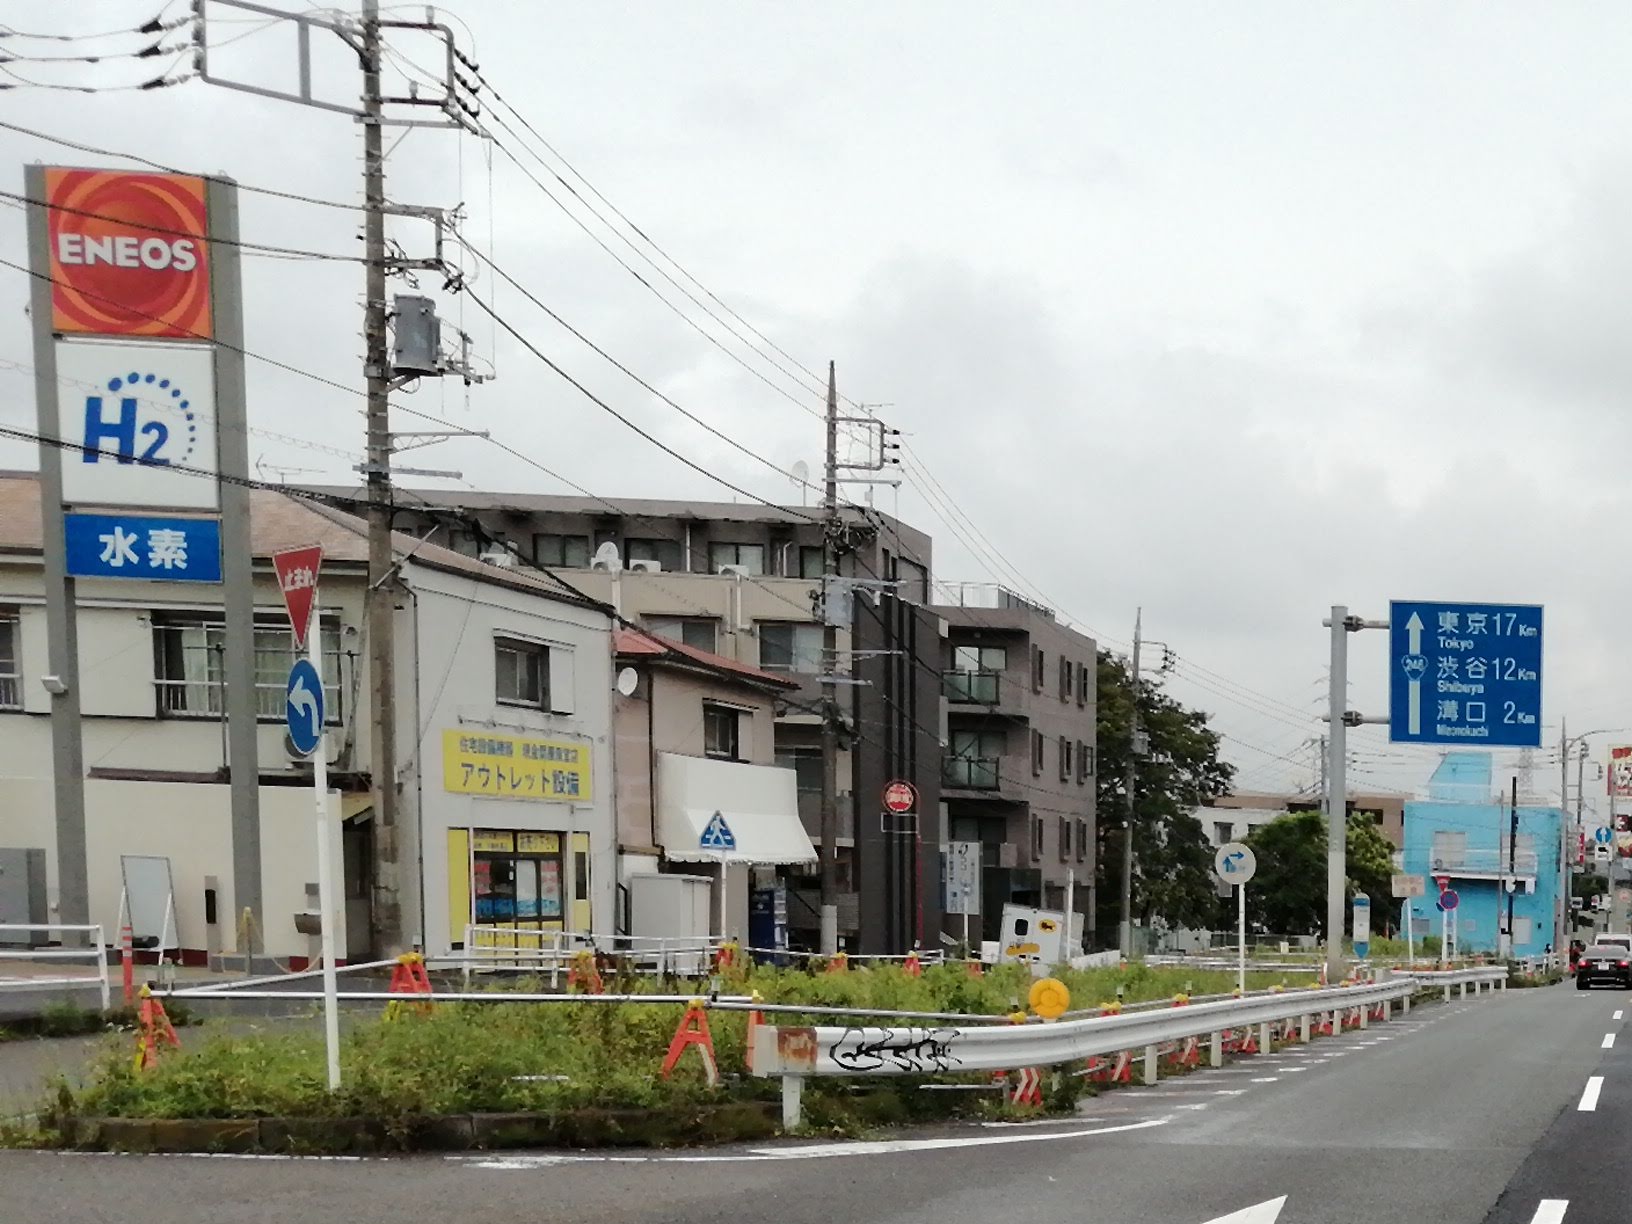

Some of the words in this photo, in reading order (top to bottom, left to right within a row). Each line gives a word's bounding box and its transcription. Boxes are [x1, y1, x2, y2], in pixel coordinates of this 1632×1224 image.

[57, 232, 197, 273] ENEOS
[82, 397, 170, 467] H2
[98, 526, 189, 570] 水素
[284, 565, 314, 591] 止まれ
[1437, 611, 1488, 634] 東京
[1438, 637, 1474, 652] Tokyo
[1437, 656, 1488, 679] 渋谷
[1437, 680, 1485, 696] Shibuya
[1437, 700, 1486, 723] 溝口
[460, 762, 580, 796] アウトレット設備
